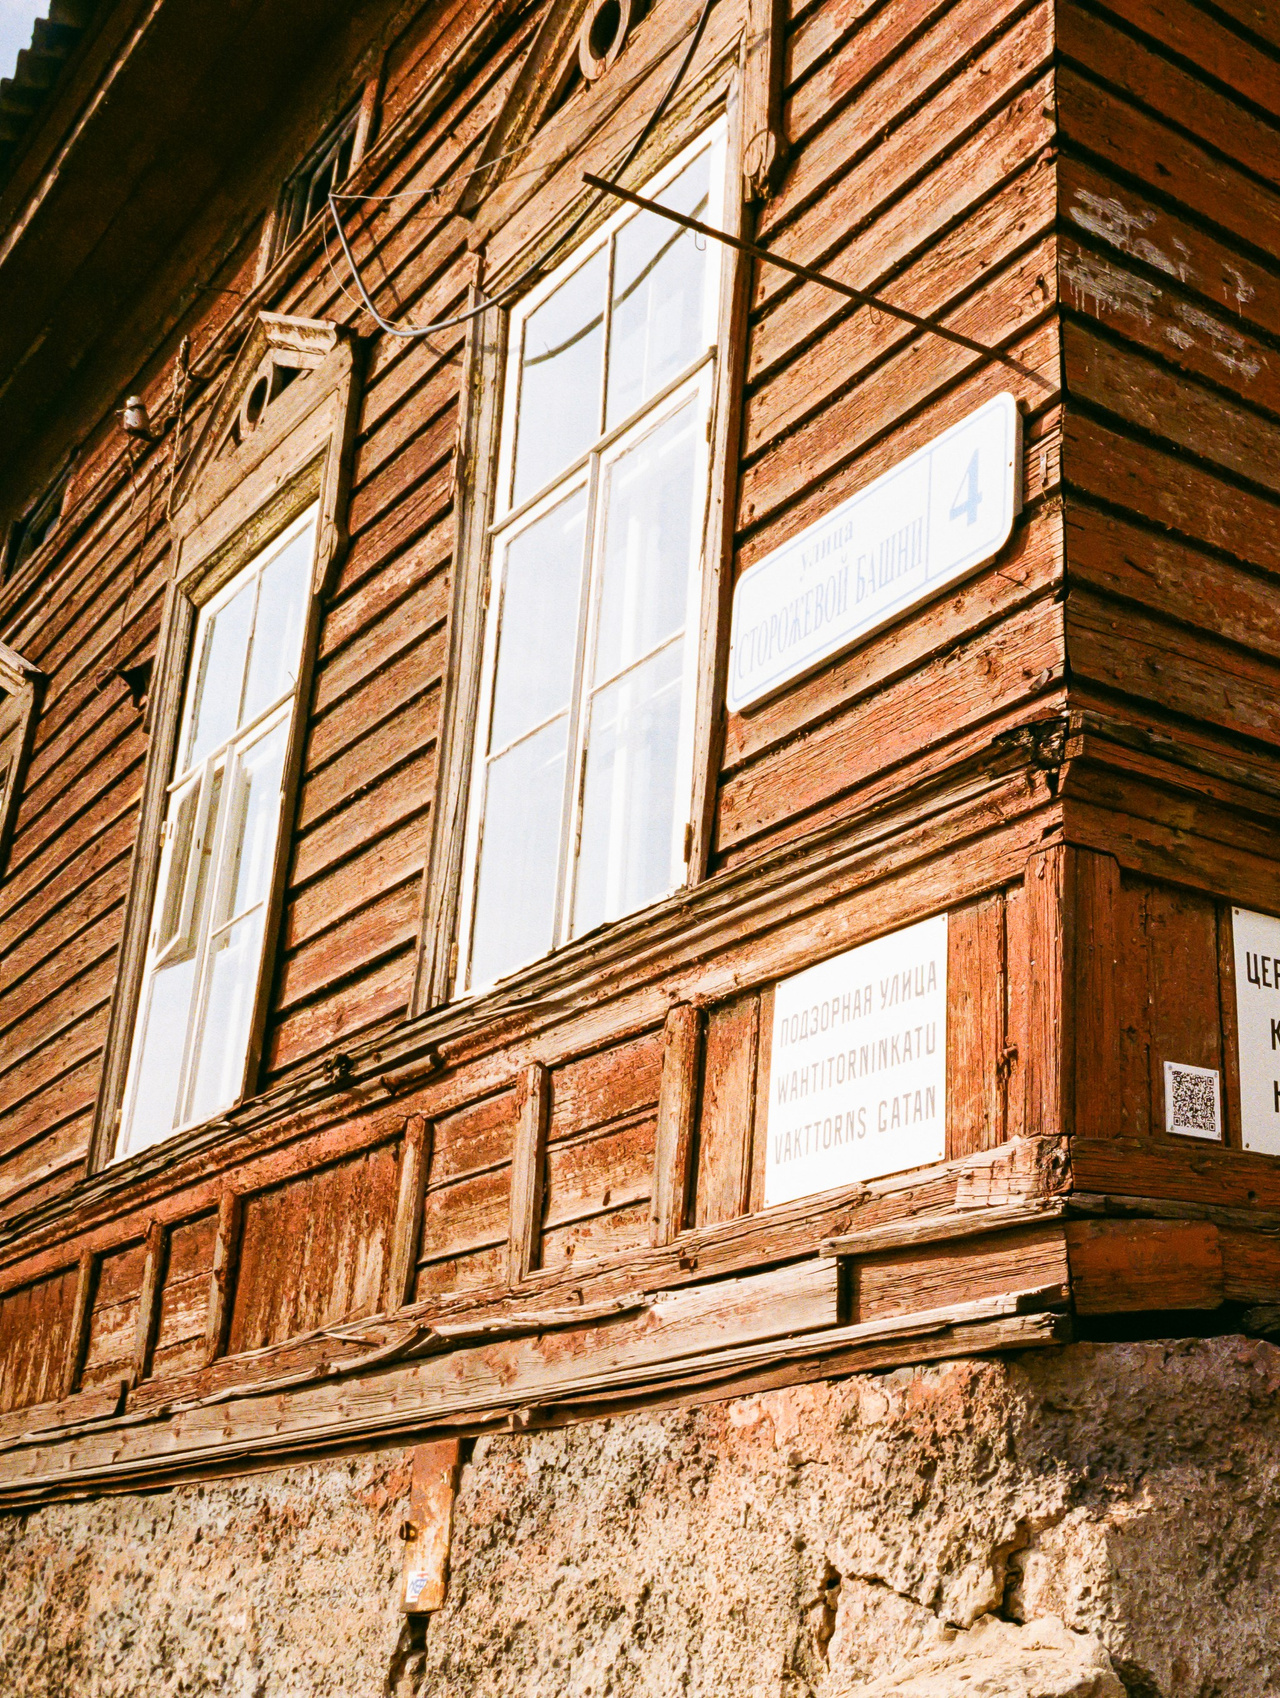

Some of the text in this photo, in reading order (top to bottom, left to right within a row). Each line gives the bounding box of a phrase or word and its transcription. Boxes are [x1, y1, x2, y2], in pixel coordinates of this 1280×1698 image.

[949, 448, 983, 527] 4
[799, 518, 854, 582] улица
[737, 515, 924, 680] СТОРОЖЕВОЙ БАШНИ
[780, 960, 937, 1048] ПОДЗОРНАЯ УЛИЦА
[777, 1021, 936, 1106] WAHTITORNINKATU
[774, 1085, 936, 1165] VAKTTORNS GATAN
